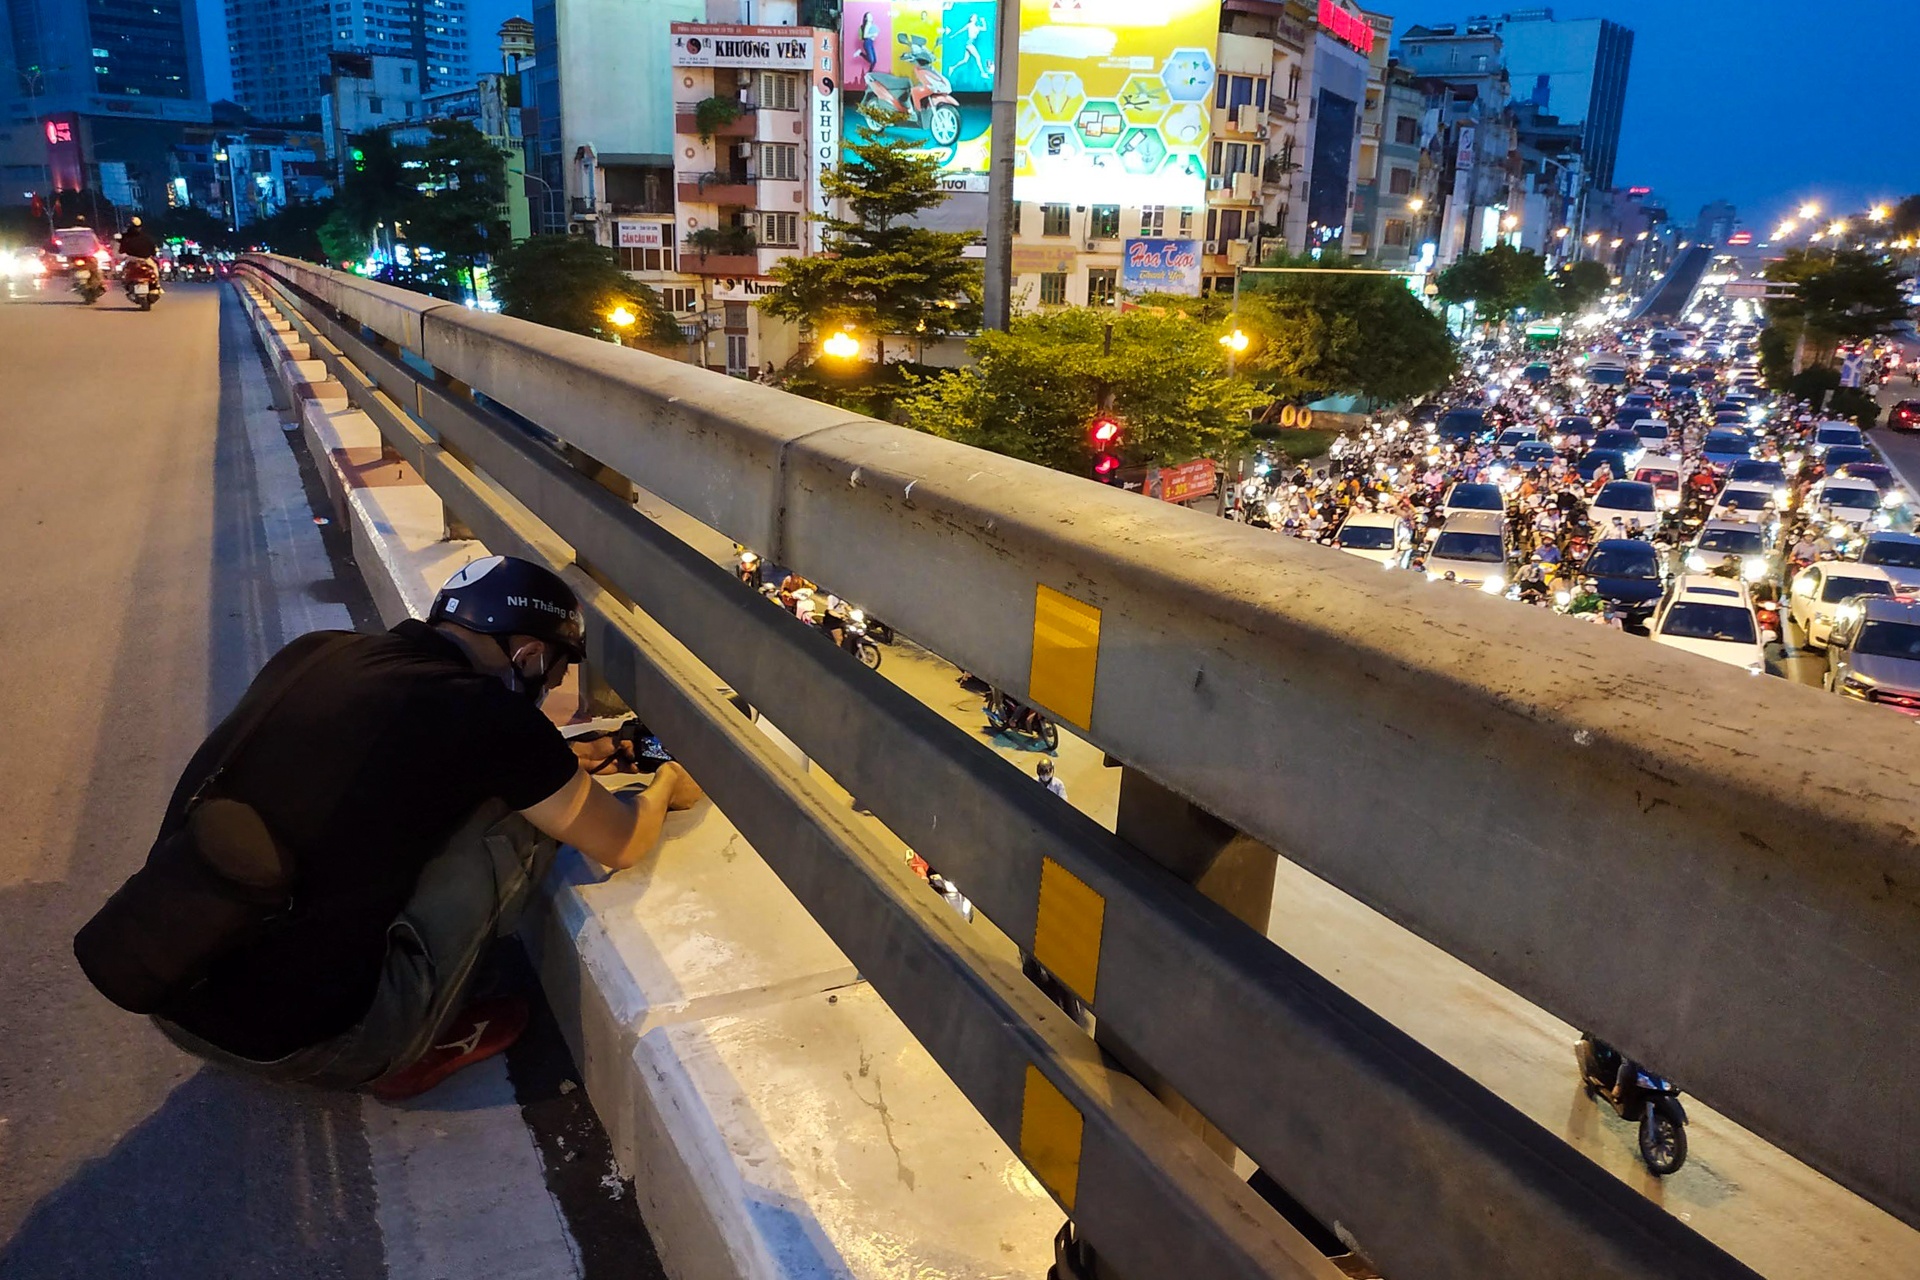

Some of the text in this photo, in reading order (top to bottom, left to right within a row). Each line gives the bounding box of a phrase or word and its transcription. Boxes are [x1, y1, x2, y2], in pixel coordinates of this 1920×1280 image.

[715, 39, 770, 58] KHƯƠNG
[776, 39, 807, 59] VIÊN
[1129, 242, 1195, 268] Hoa Tươi
[507, 595, 528, 607] NH
[532, 598, 567, 619] Thắng
